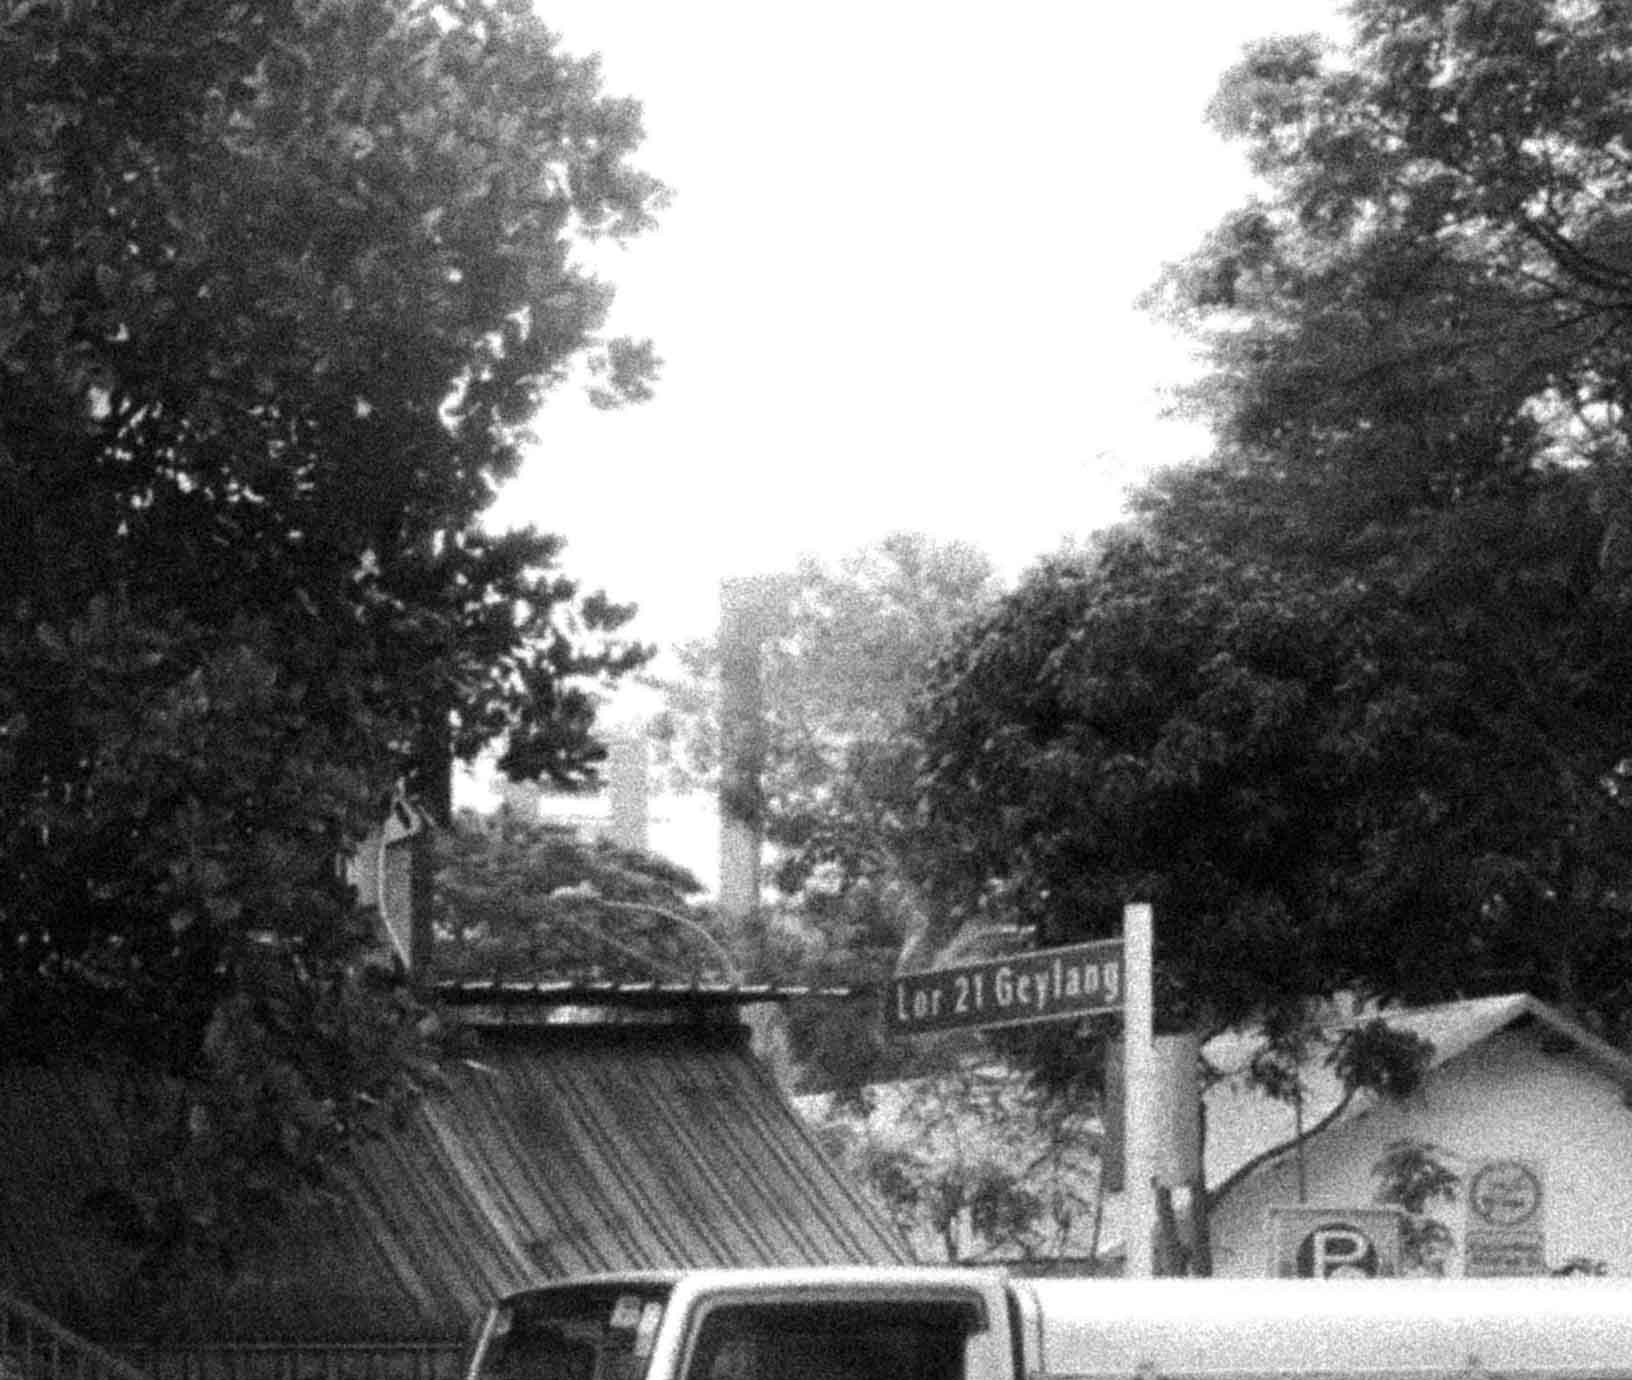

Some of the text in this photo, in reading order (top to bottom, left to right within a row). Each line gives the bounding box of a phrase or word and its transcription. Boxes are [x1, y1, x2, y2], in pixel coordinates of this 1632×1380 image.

[897, 958, 1120, 1020] Lor 21 Geylang
[1313, 1229, 1367, 1279] P
